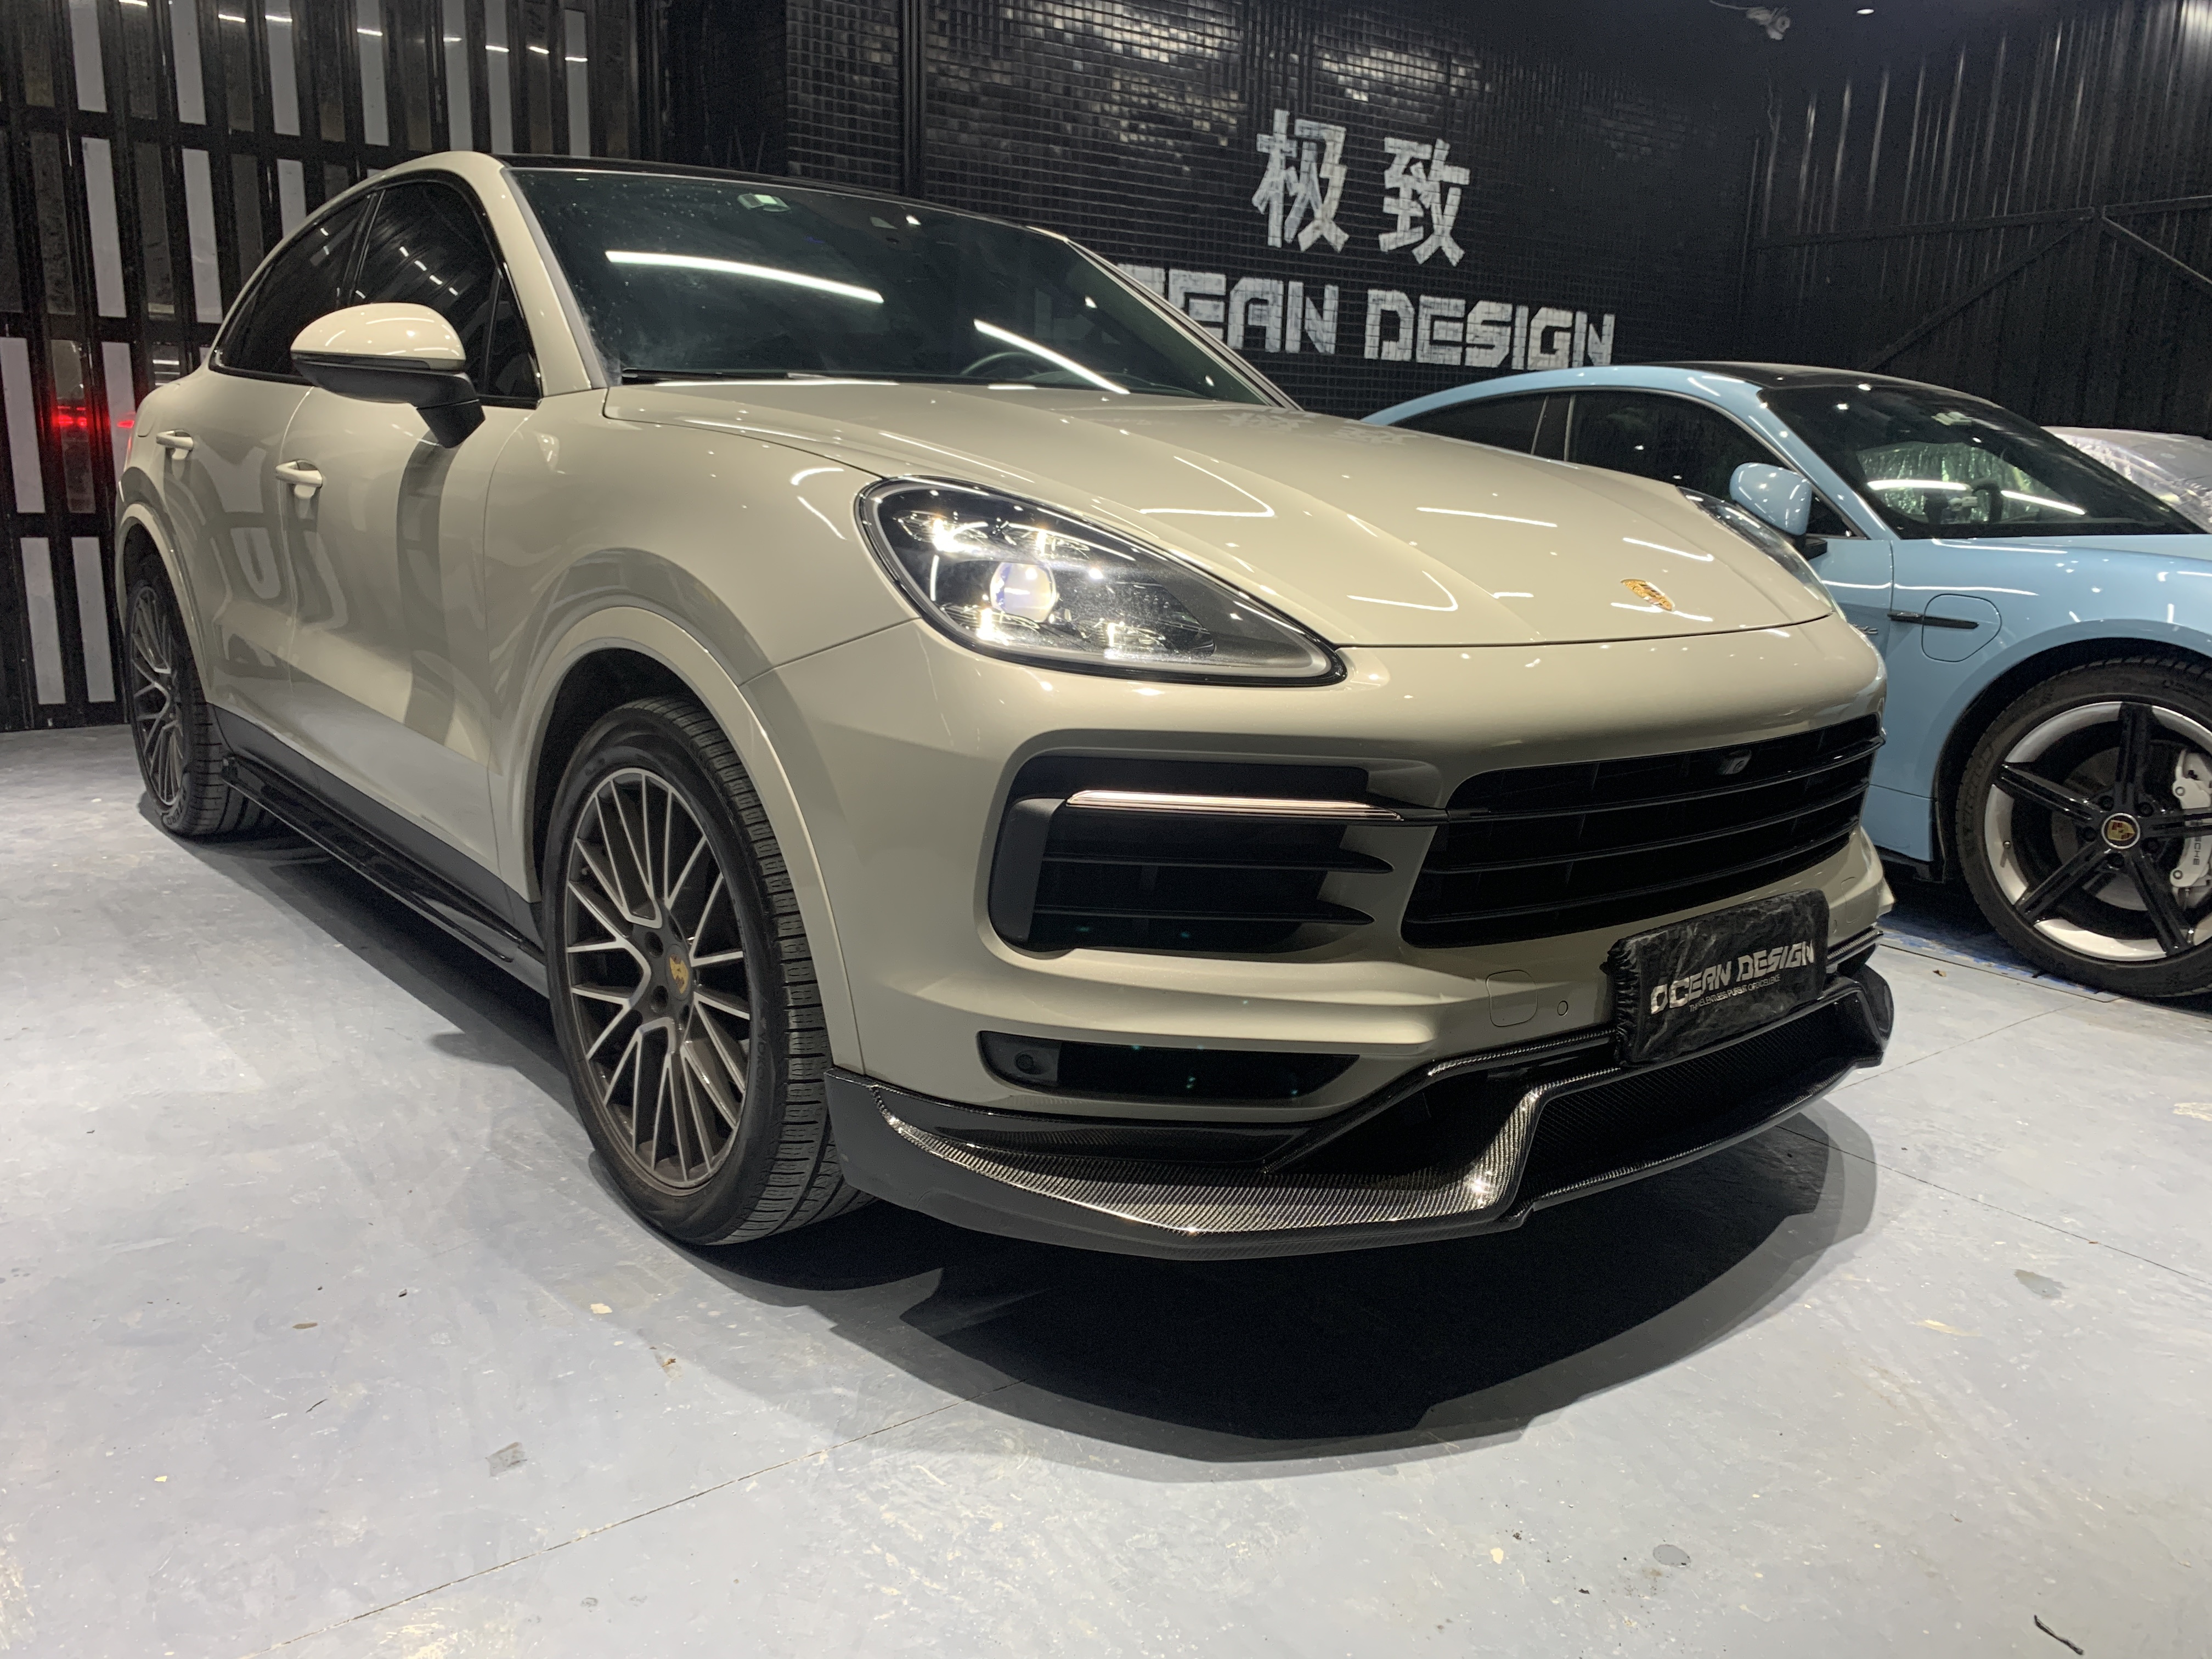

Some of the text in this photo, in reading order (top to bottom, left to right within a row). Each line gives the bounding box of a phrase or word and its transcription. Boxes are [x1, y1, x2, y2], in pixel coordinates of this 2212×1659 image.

[1252, 109, 1470, 267] 极致
[1118, 263, 1615, 371] EAN DESIGN
[1651, 941, 1814, 1014] OCEAN DESIGN
